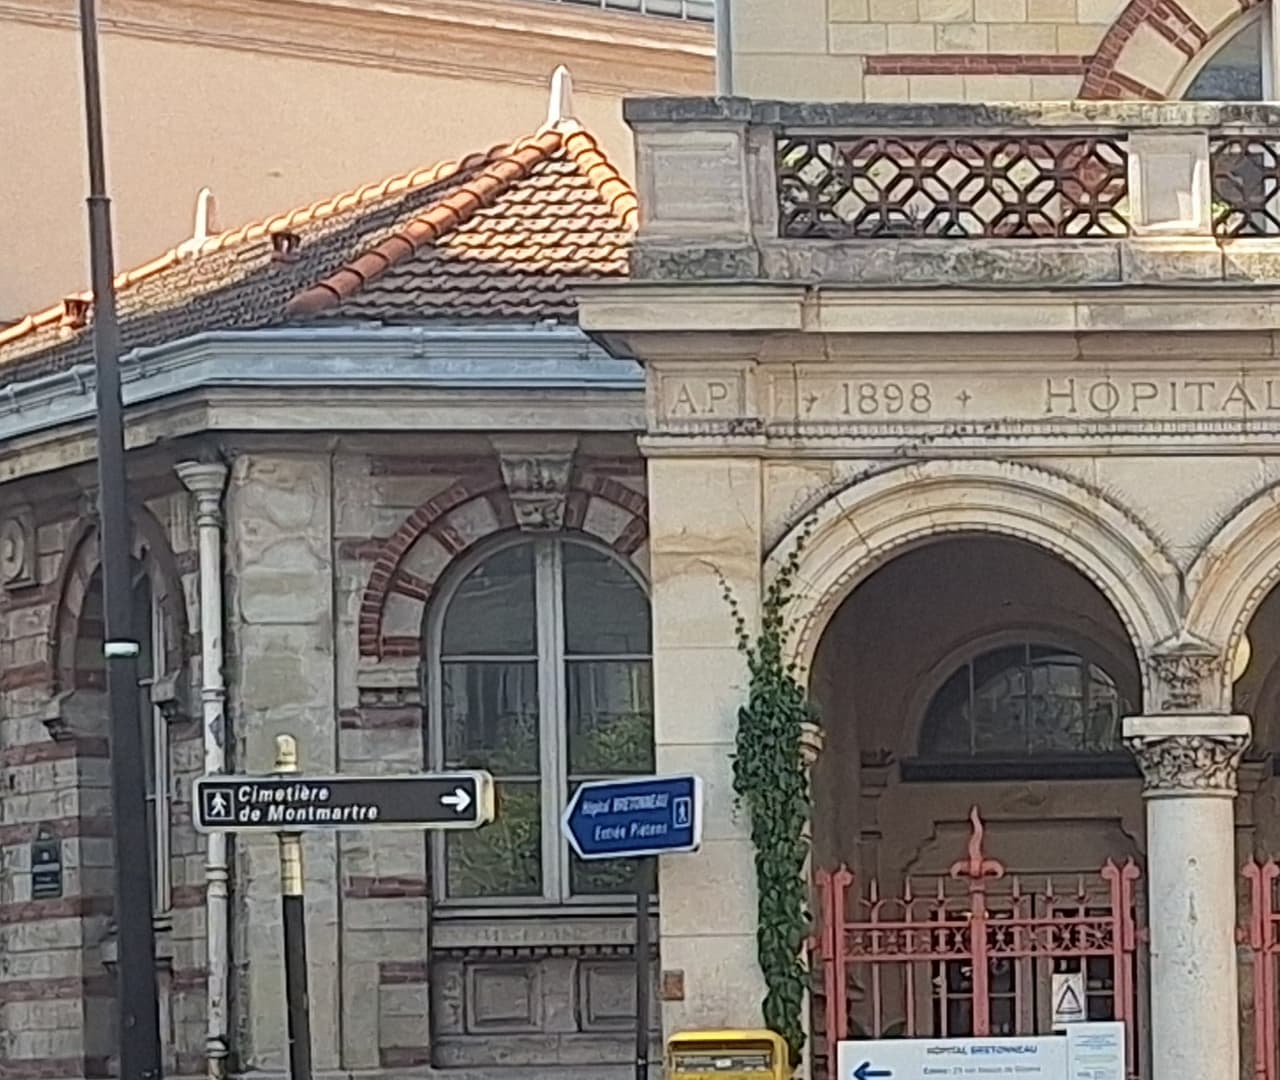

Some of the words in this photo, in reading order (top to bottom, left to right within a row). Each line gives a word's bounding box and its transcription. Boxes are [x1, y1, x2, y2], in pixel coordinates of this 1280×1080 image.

[842, 382, 932, 414] 1898
[238, 783, 330, 803] Cimetière
[613, 793, 669, 812] BRETONNEAU
[239, 804, 262, 822] de
[267, 804, 378, 822] Montmartre
